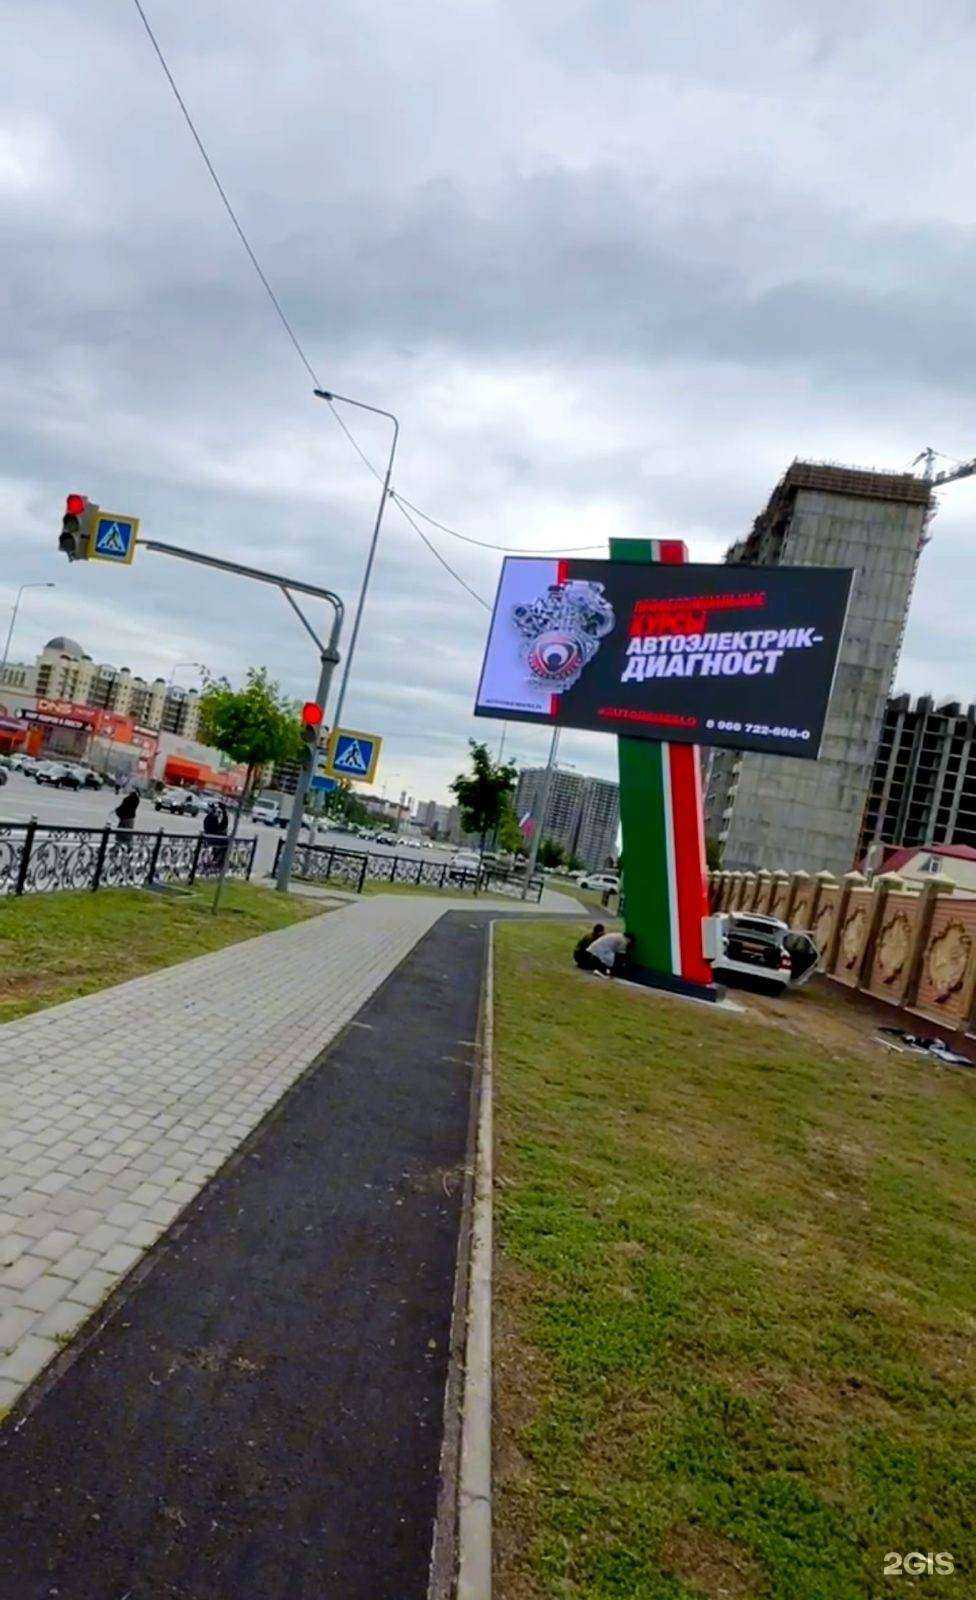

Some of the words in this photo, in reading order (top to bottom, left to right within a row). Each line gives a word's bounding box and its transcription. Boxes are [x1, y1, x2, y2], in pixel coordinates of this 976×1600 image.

[626, 627, 824, 656] АВТОЭЛЕКТРИК-
[621, 650, 784, 682] ДИАГНОСТ
[705, 719, 715, 729] 8
